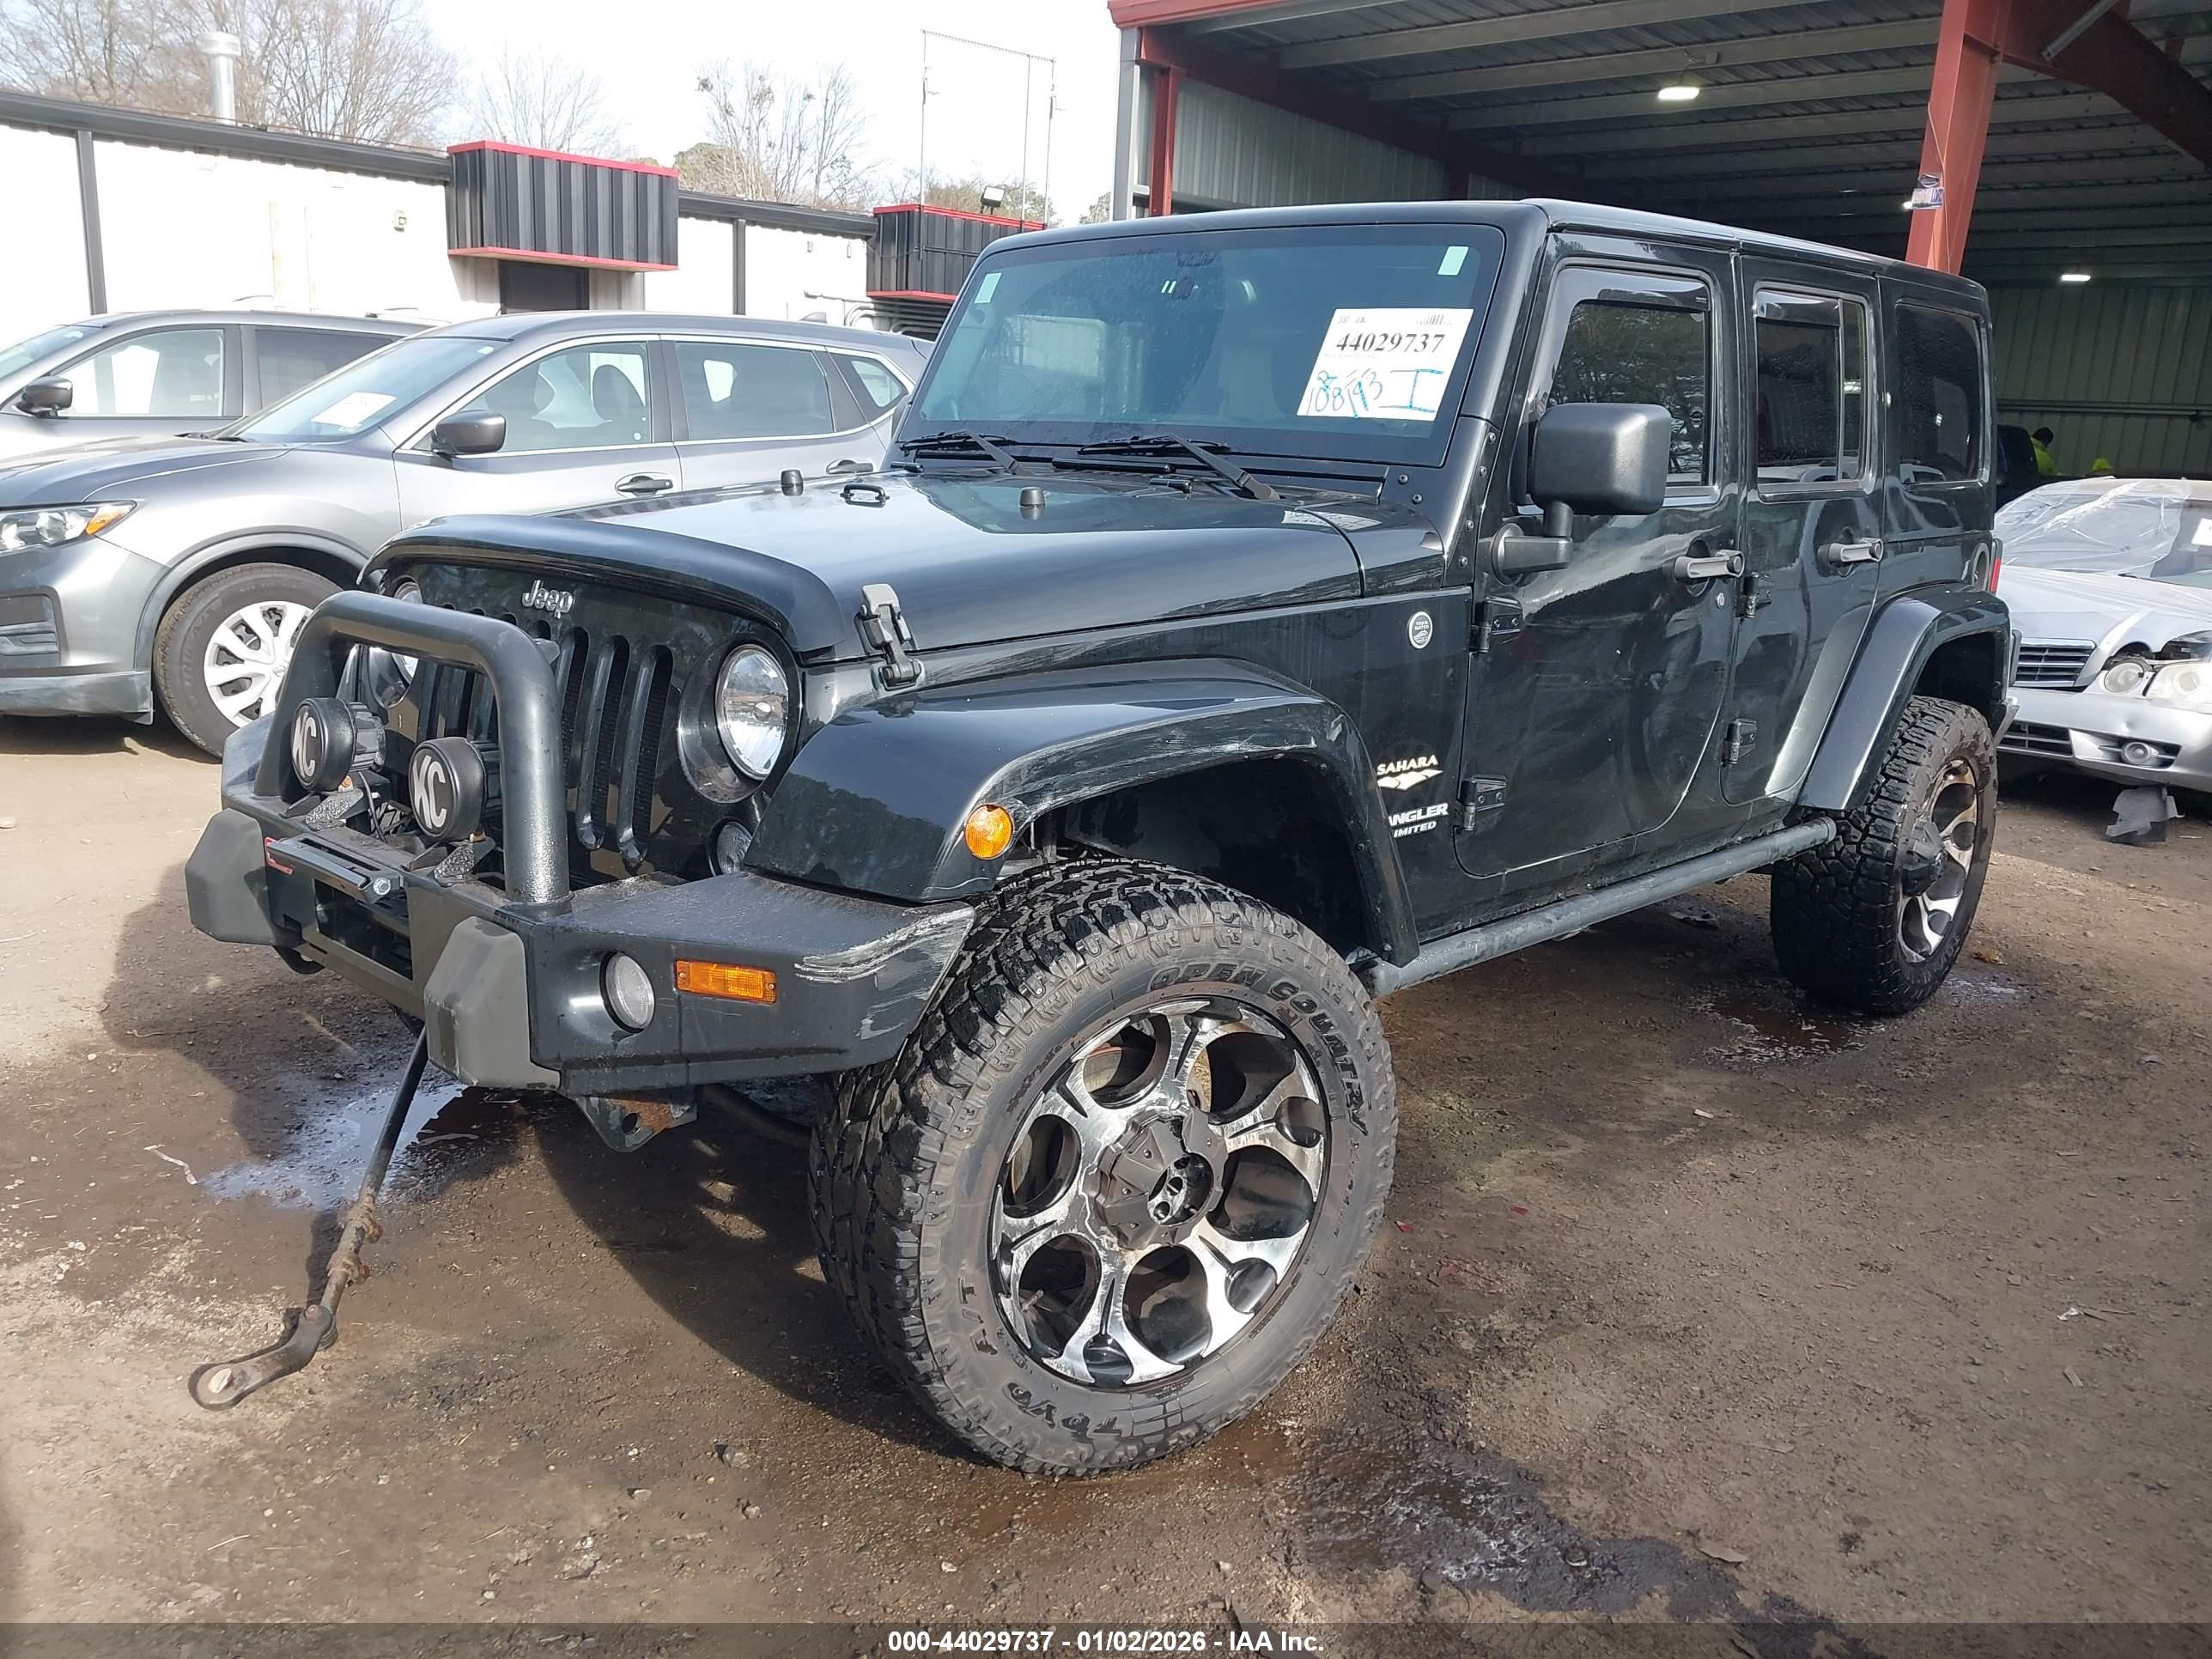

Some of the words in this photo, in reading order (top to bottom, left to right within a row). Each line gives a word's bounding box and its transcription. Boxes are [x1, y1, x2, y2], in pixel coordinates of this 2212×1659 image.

[1336, 332, 1445, 352] 44029737
[521, 580, 574, 619] Jeep
[291, 711, 317, 778] KC
[1376, 755, 1438, 775] SAHARA
[412, 754, 447, 829] KC
[1150, 963, 1267, 990] OPEN
[1268, 981, 1370, 1137] COUNTRY
